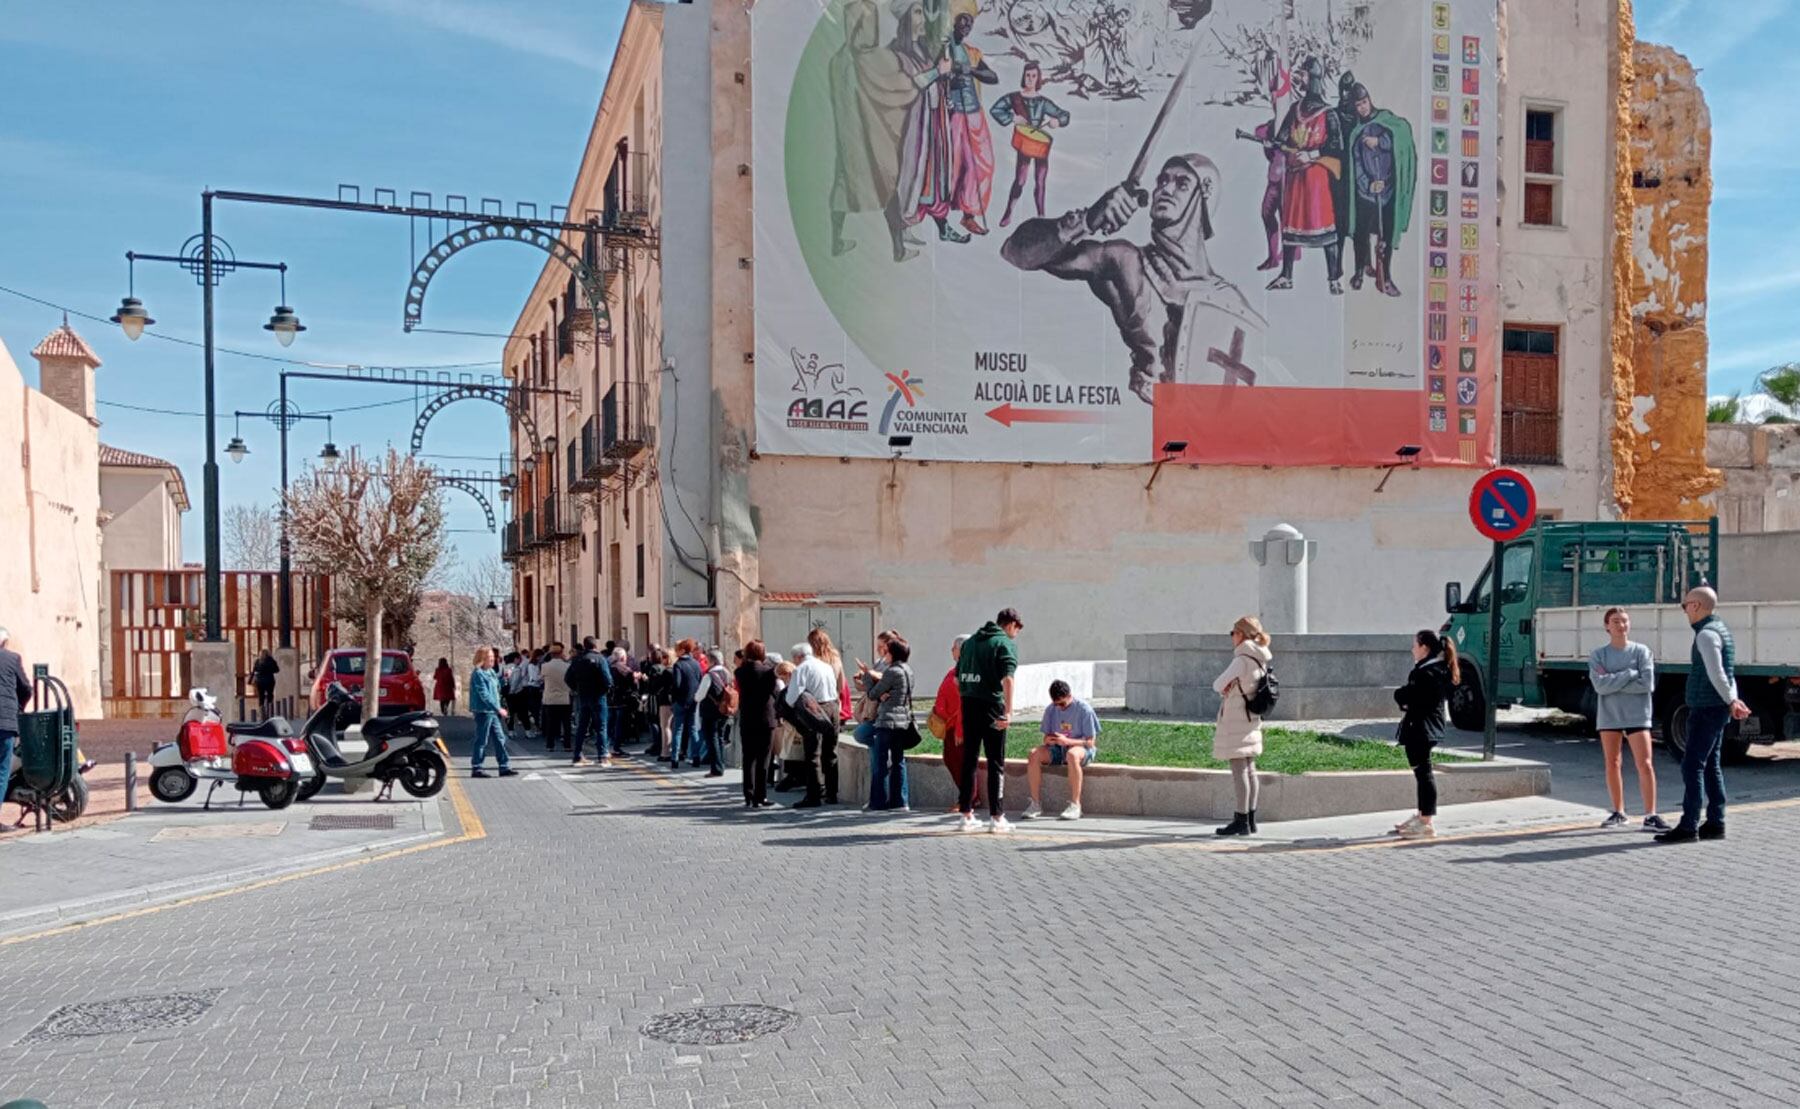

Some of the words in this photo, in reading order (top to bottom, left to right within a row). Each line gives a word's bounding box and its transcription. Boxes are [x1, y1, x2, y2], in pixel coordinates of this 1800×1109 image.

[975, 352, 1027, 373] MUSEU
[975, 379, 1028, 403] ALCOIÀ
[1033, 384, 1052, 403] DE
[1056, 385, 1074, 404] LA
[1079, 386, 1121, 405] FESTA
[897, 410, 968, 423] COMUNITAT
[894, 422, 969, 435] VALENCIANA
